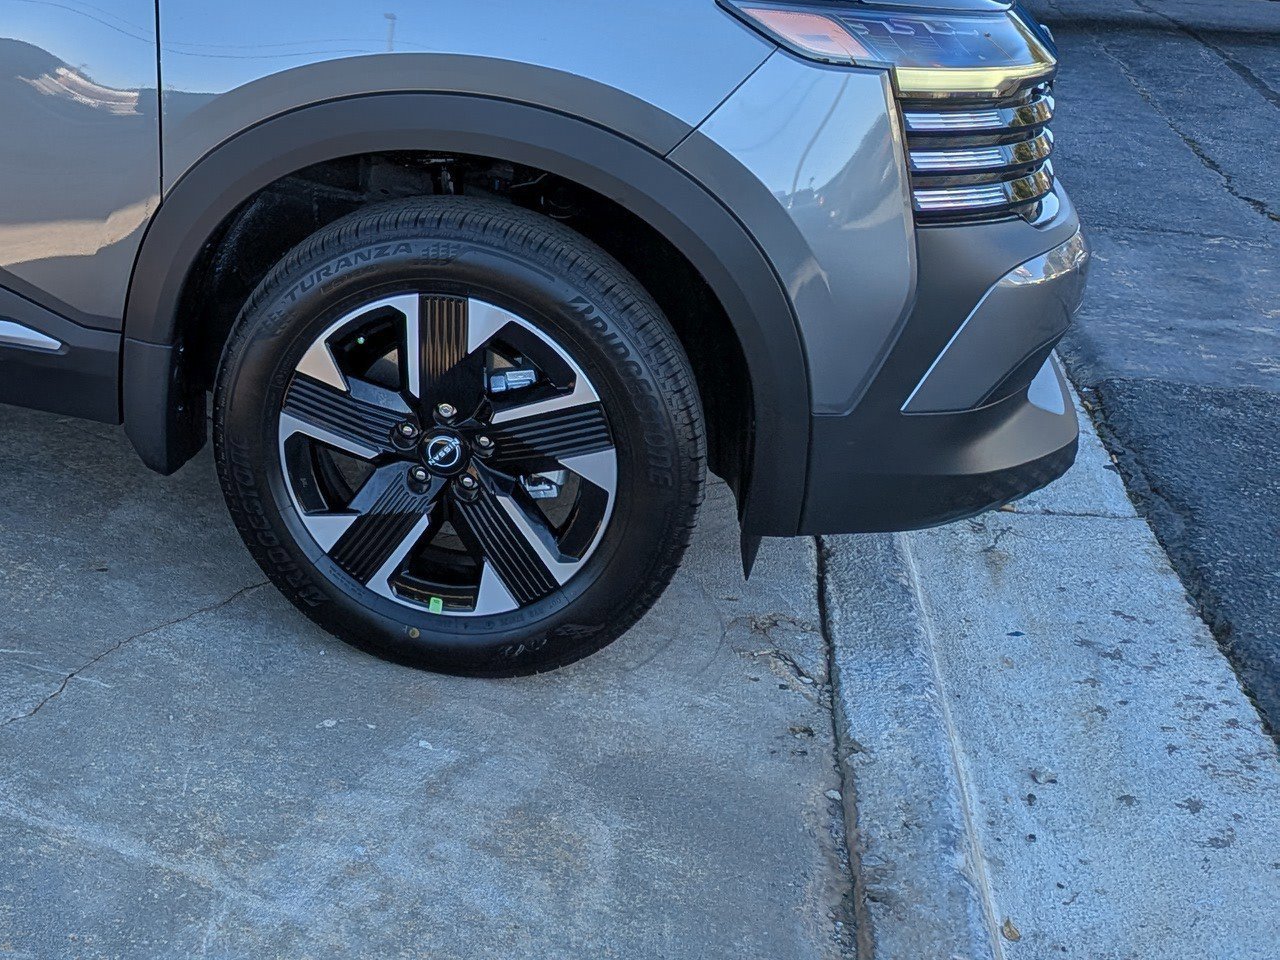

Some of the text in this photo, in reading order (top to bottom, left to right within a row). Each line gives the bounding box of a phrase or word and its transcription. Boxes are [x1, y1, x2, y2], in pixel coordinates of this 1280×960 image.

[285, 242, 412, 303] TURANZA
[567, 295, 673, 488] BRIDGESTONE
[427, 437, 460, 466] NISSAN
